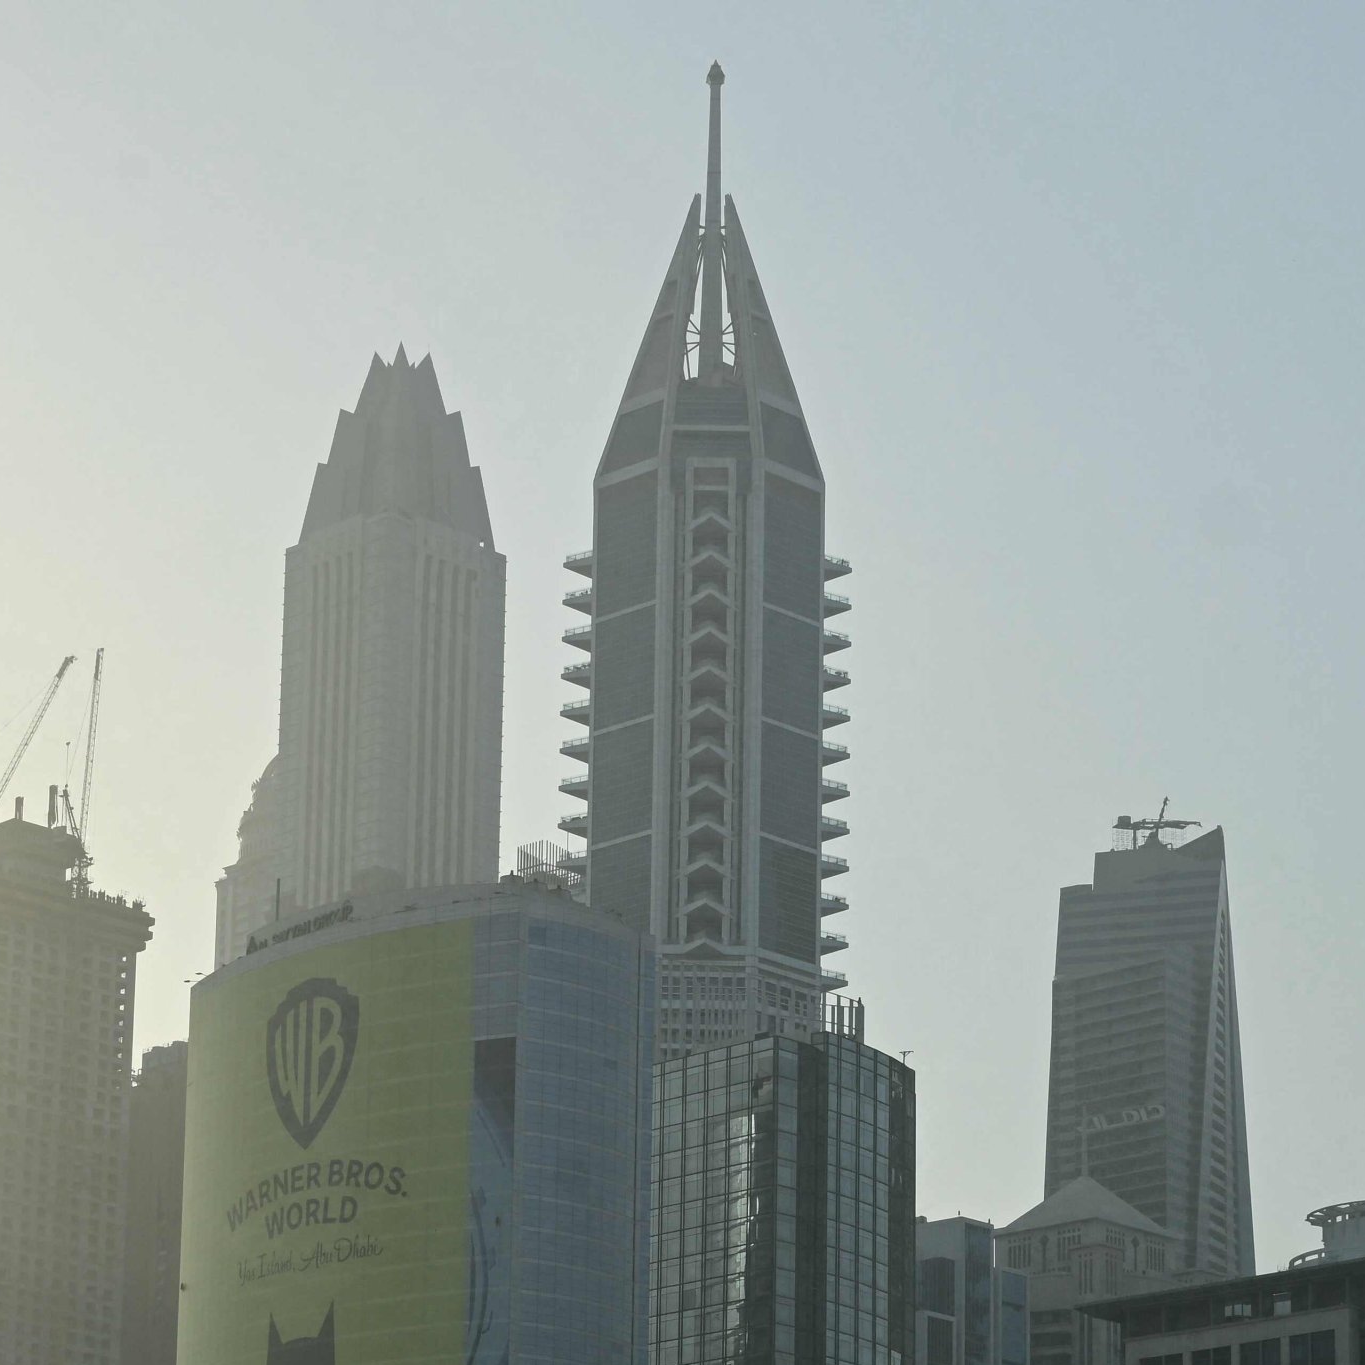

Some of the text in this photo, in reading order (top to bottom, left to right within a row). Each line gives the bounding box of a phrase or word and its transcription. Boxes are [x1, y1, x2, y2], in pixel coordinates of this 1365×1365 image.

[273, 995, 345, 1129] WB
[226, 1158, 409, 1232] WARNER BROS.
[264, 1195, 358, 1239] WORLD
[299, 1237, 334, 1272] Abu
[336, 1234, 385, 1264] Dhabi
